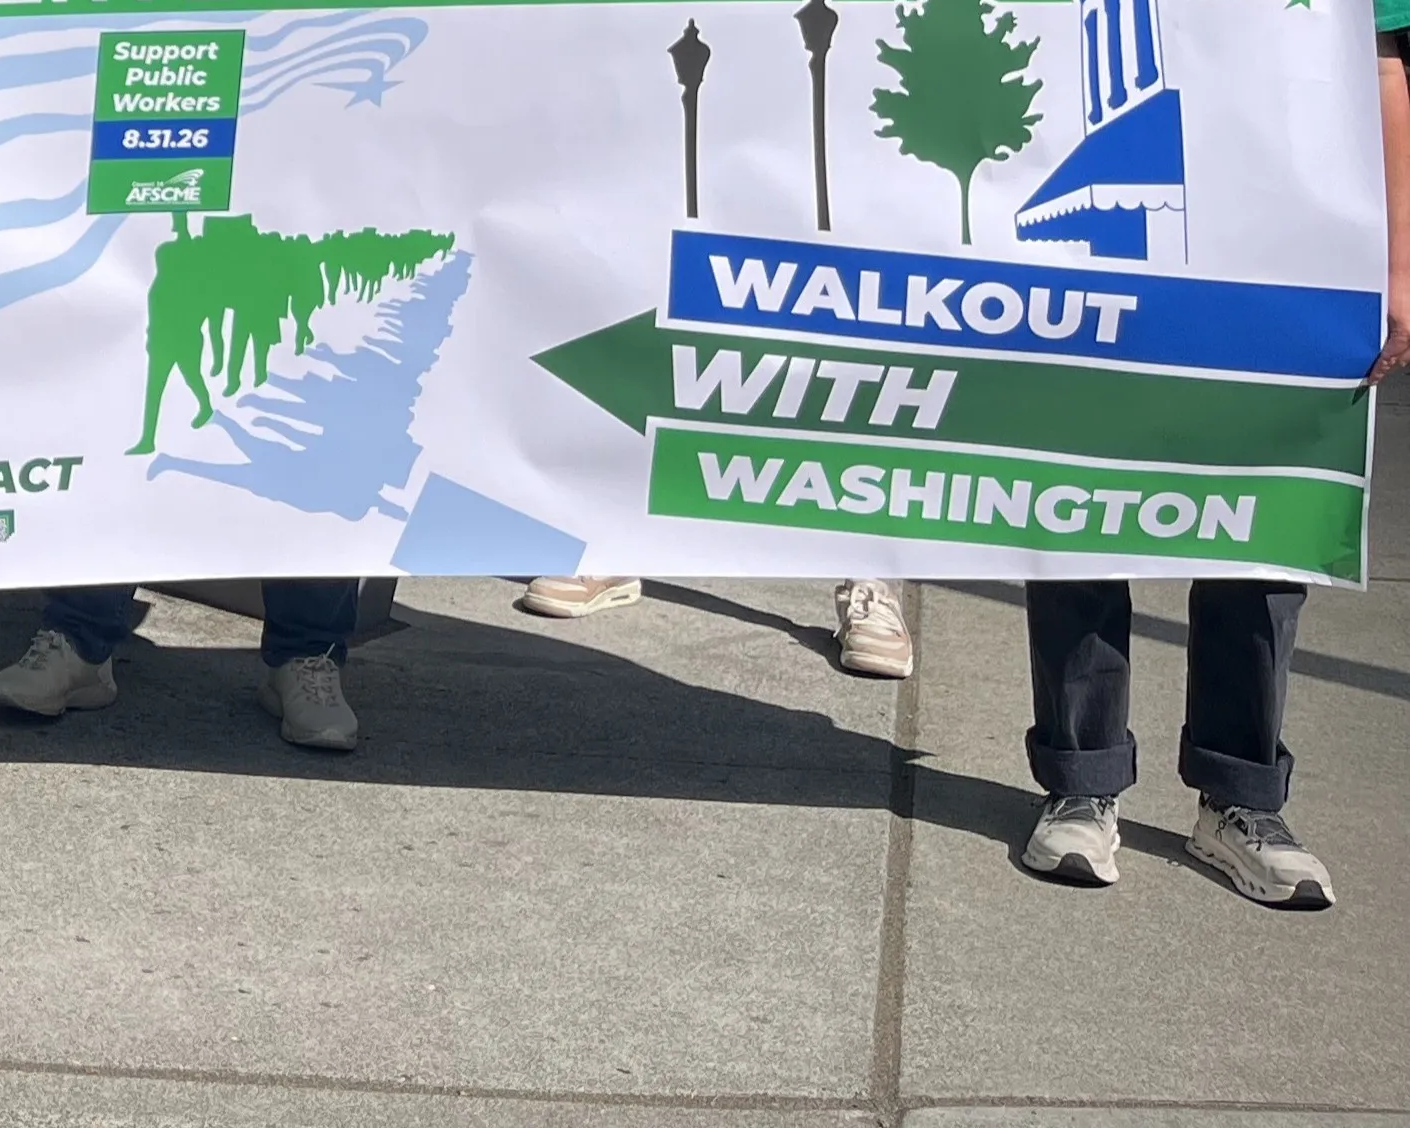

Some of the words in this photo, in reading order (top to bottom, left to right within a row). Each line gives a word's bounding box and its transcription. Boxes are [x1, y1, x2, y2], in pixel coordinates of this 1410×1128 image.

[113, 42, 219, 64] Support
[125, 65, 207, 86] Public
[113, 92, 221, 112] Workers
[122, 129, 210, 148] 8.31.26
[125, 187, 201, 201] AFSCME
[709, 254, 1137, 344] WALKOUT
[671, 344, 957, 430] WITH
[698, 452, 1256, 543] WASHINGTON
